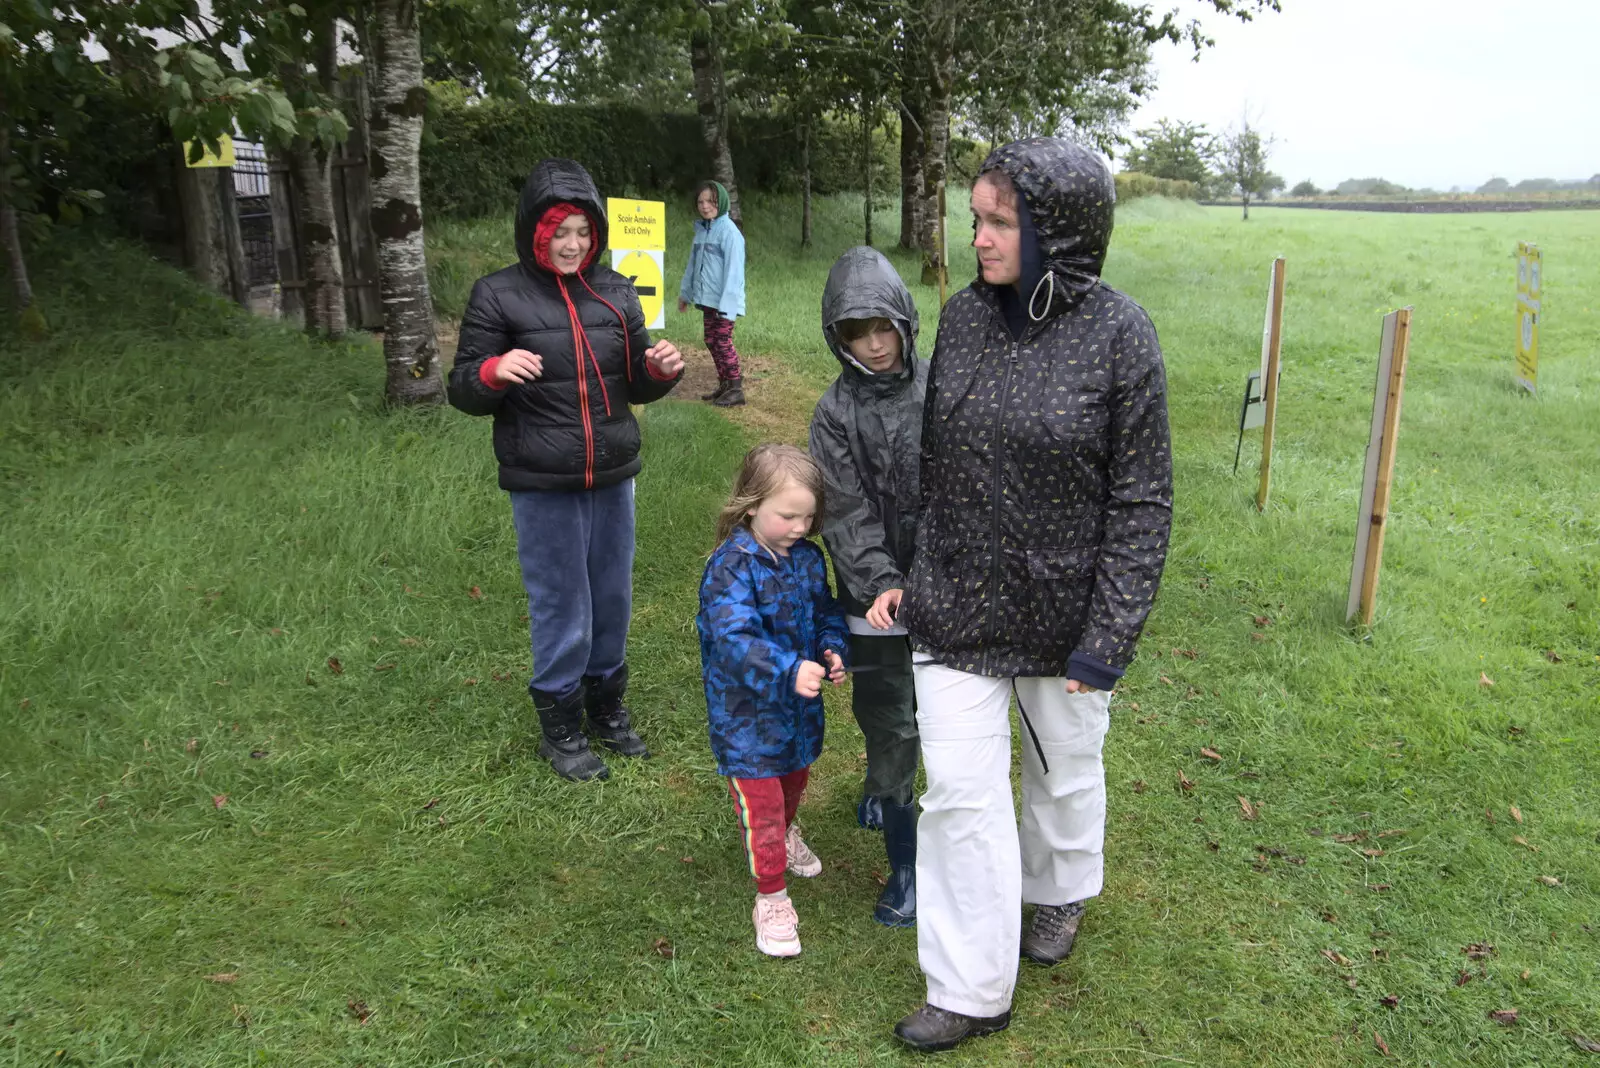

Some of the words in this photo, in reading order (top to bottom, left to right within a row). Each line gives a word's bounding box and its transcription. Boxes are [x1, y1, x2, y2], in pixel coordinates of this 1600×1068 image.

[617, 214, 633, 223] Scoir
[624, 226, 636, 235] Exit
[637, 226, 651, 237] Only
